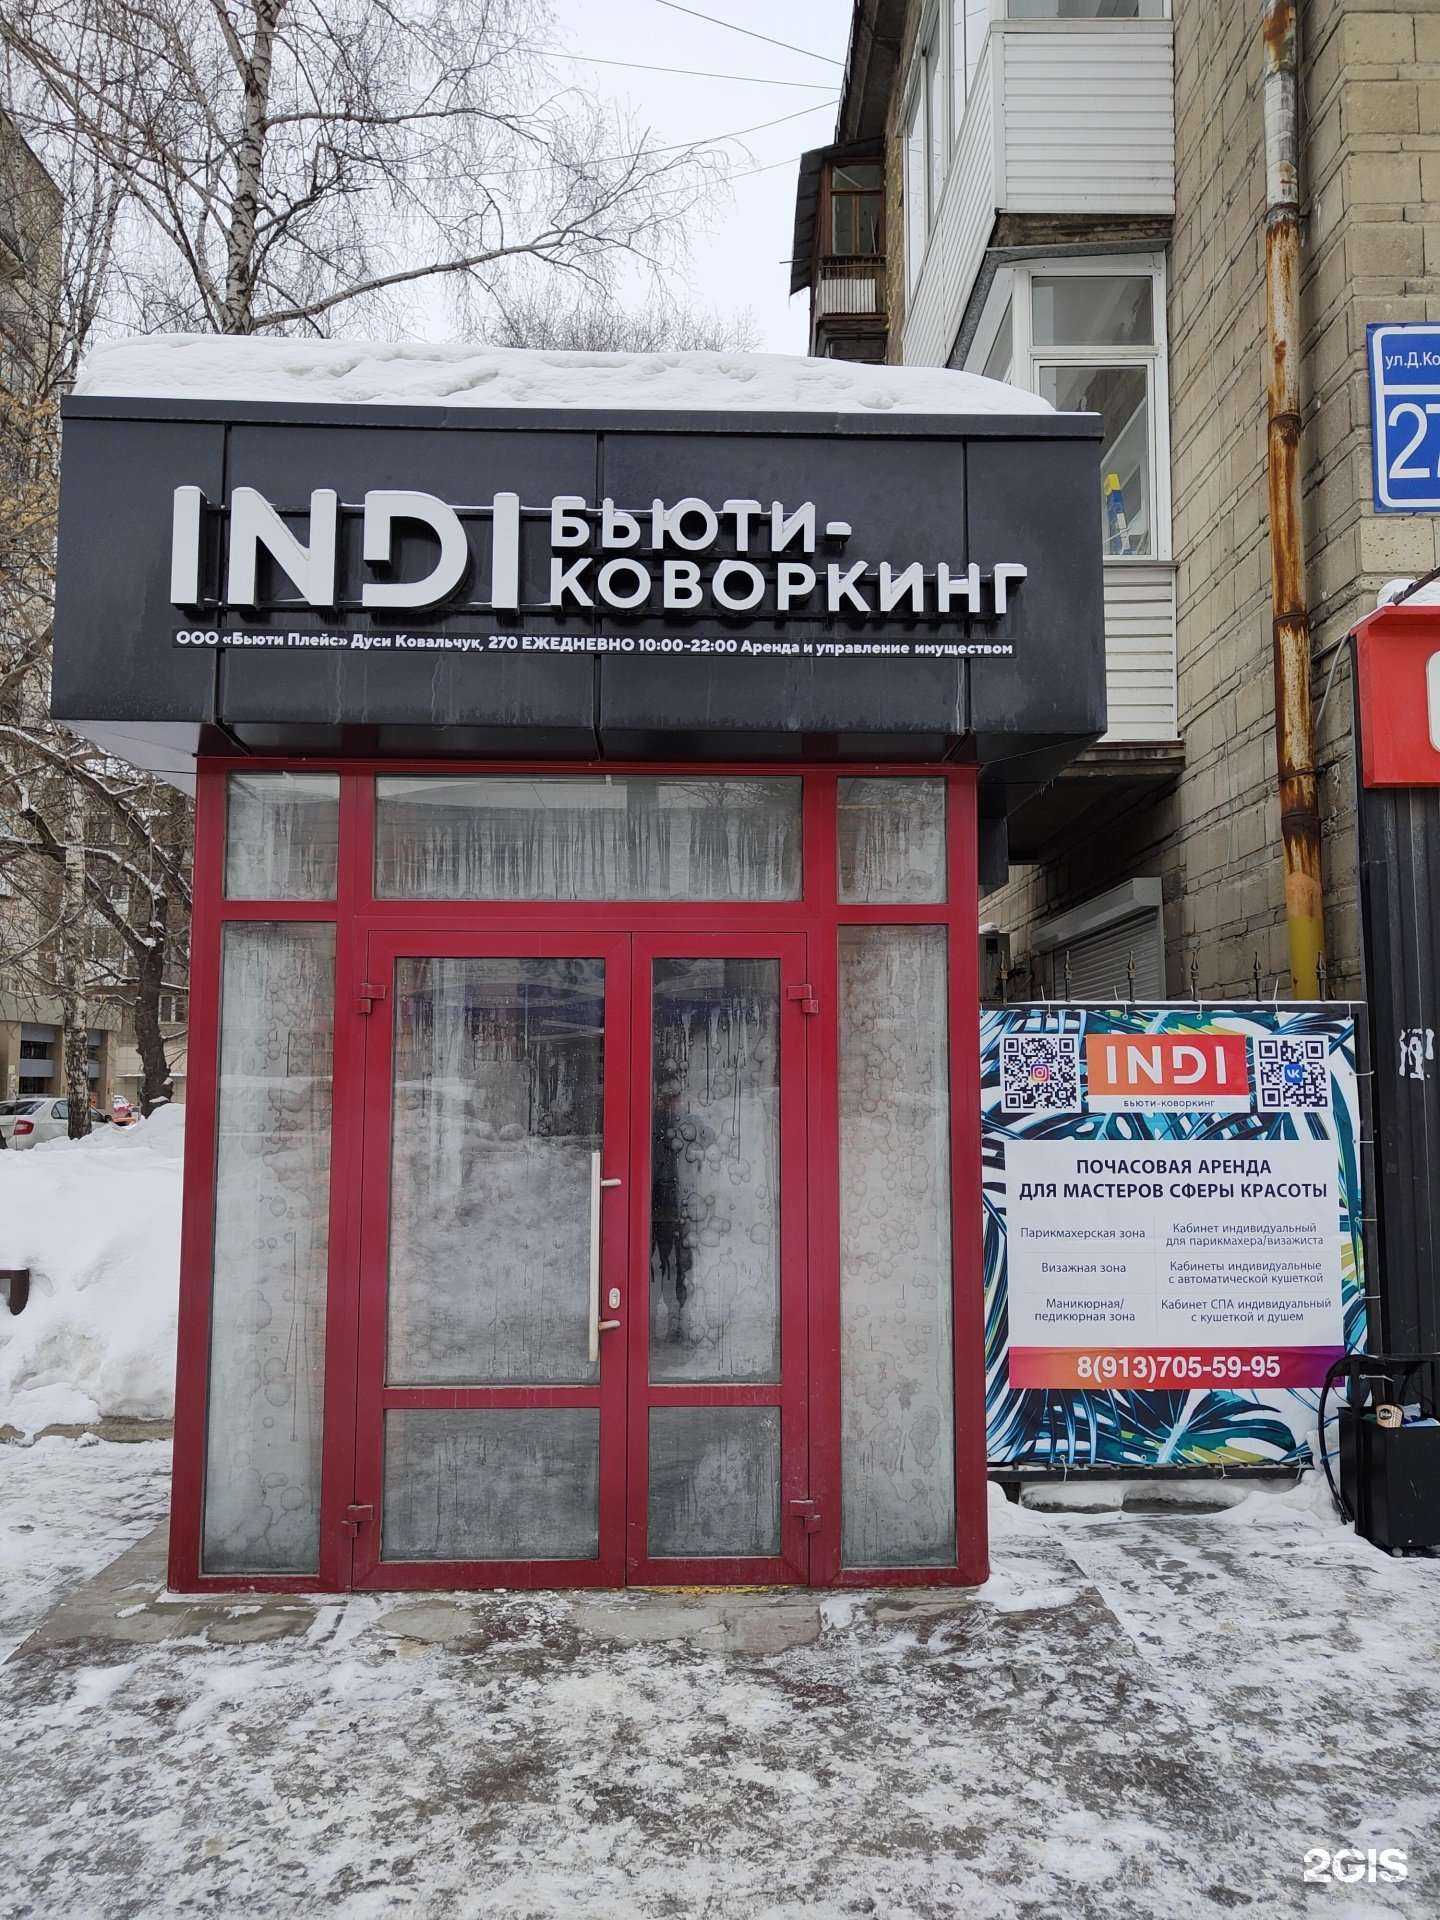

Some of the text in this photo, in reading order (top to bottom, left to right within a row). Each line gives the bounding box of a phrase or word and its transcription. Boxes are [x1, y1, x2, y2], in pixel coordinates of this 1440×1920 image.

[550, 496, 852, 553] БЬЮТИ-
[170, 485, 520, 609] INDI
[550, 557, 1028, 614] КОВОРКИНГ
[175, 630, 1013, 658] ООО «Бьюти Плейс» Дуси Ковальчук, 270 ЕЖЕДНЕВНО 10:00-22:00 Аренда и управление имуществом
[1106, 1045, 1227, 1085] INDI
[1076, 1159, 1272, 1177] ПОЧАСОВАЯ АРЕНДА
[1018, 1182, 1327, 1201] ДЛЯ МАСТЕРОВ СФЕРЫ КРАСОТЫ
[1020, 1227, 1146, 1240] Парикмахерская зона
[1172, 1222, 1317, 1237] Кабинет индивидуальный
[1165, 1234, 1324, 1248] для парикмахера/визажиста
[1041, 1262, 1127, 1273] Визажная зона
[1170, 1260, 1323, 1275] Кабинеты индивидуальные
[1168, 1270, 1324, 1285] с автоматической кушеткой
[1046, 1297, 1125, 1311] Маникюрная/
[1161, 1297, 1332, 1311] Кабинет СПА индивидуальный
[1034, 1312, 1136, 1324] педикюрная зона
[1191, 1310, 1304, 1325] с кушеткой и душем
[1077, 1356, 1281, 1382] 8(913)705-59-95
